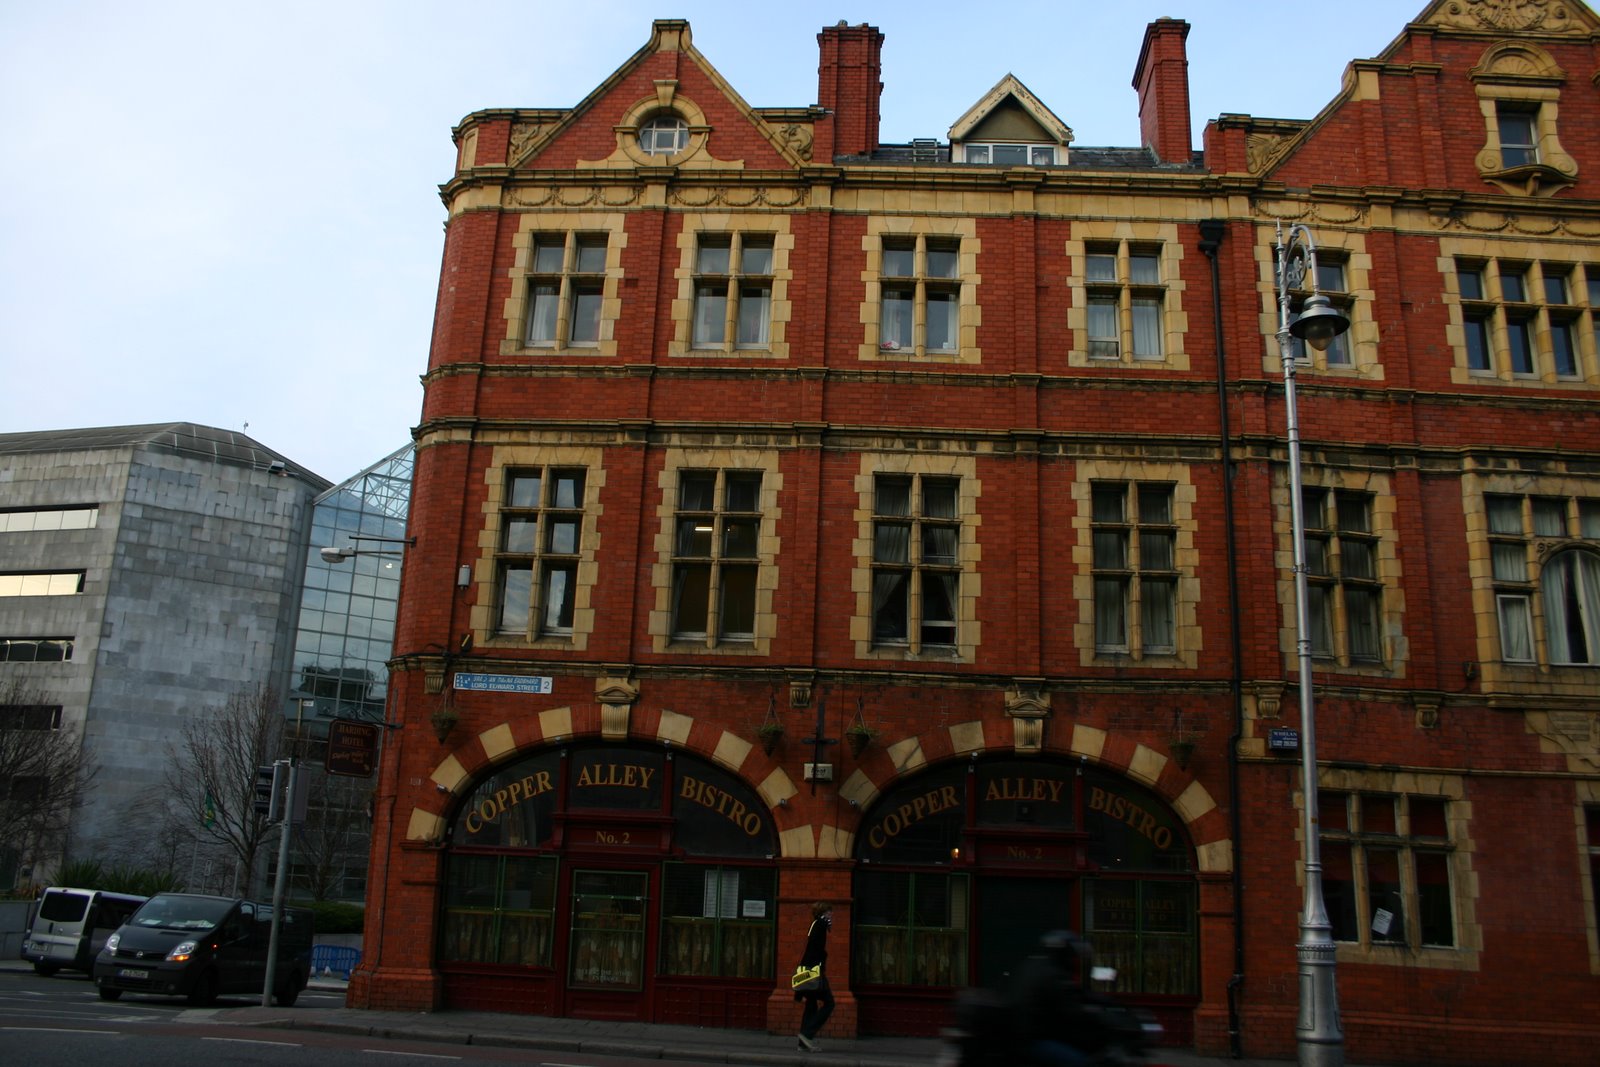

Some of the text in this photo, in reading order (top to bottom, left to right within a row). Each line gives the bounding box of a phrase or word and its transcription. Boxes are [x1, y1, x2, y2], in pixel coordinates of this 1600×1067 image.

[543, 681, 550, 690] 2
[464, 763, 763, 837] COPPER ALLEY BISTRO
[867, 777, 1173, 850] COPPER ALLEY BISTRO
[595, 830, 632, 845] No. 2
[1007, 846, 1045, 859] No. 2
